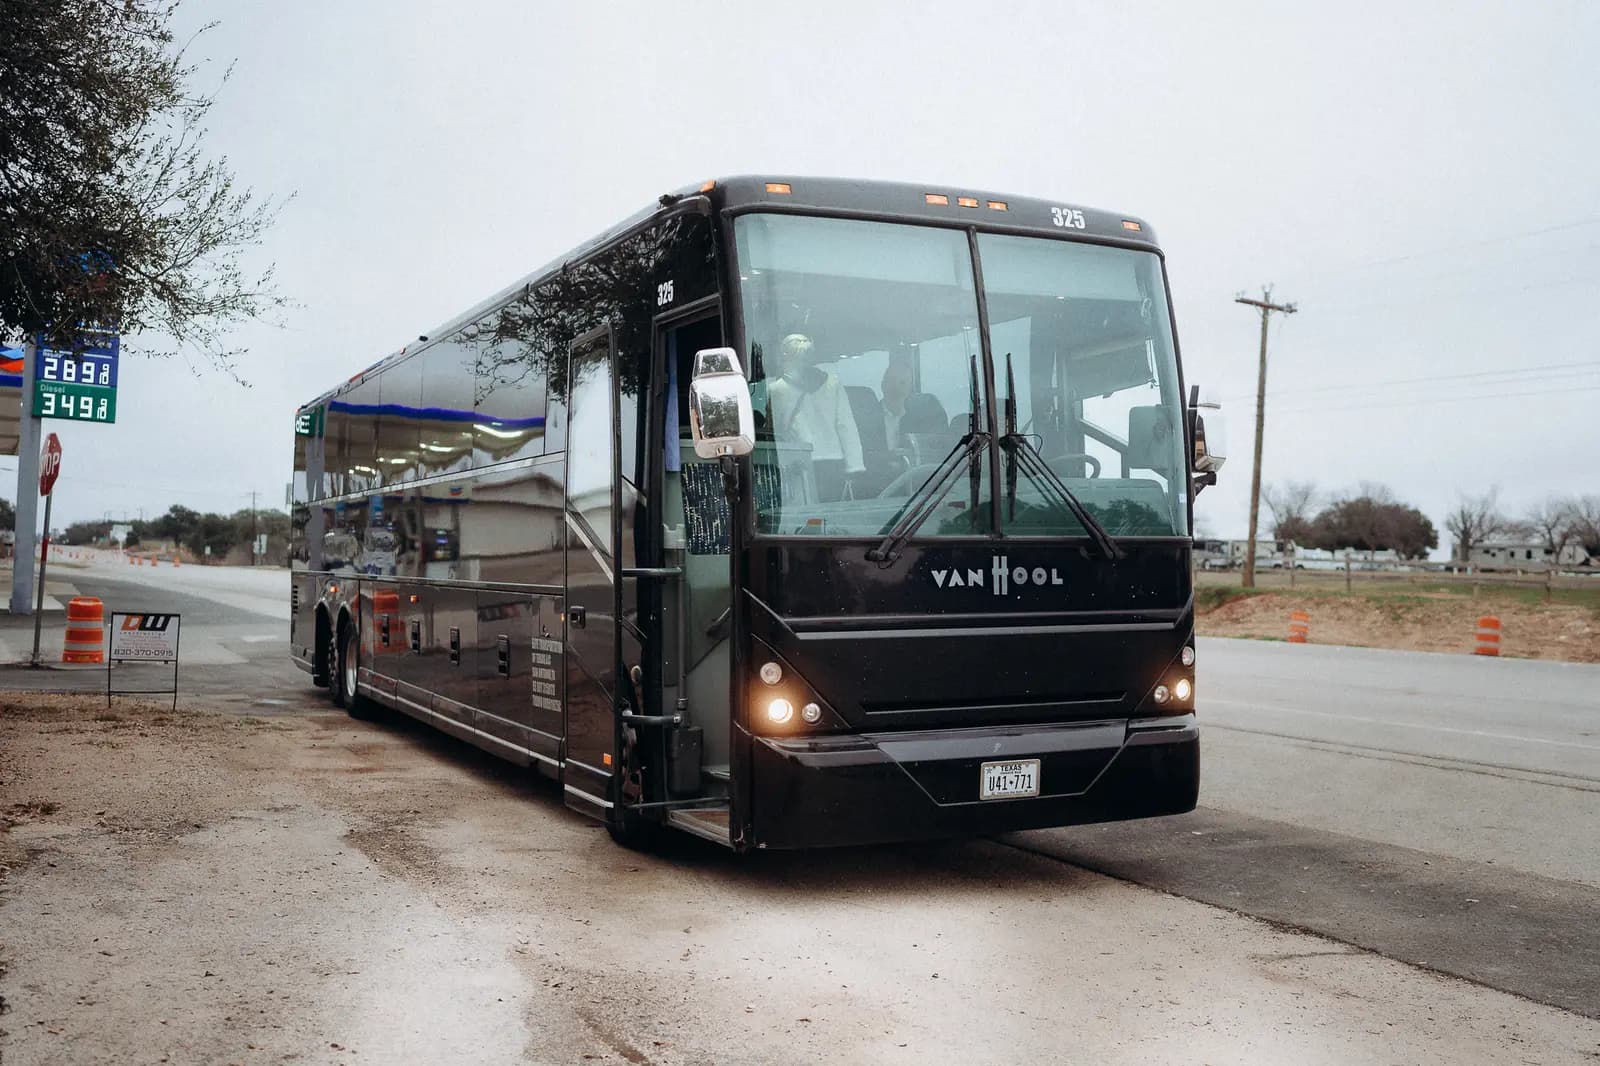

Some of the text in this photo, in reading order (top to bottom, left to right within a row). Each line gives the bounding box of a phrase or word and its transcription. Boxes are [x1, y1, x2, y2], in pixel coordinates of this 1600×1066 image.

[1051, 207, 1086, 229] 325
[657, 280, 673, 306] 325
[40, 384, 65, 394] Diesel
[931, 556, 1064, 595] VAN HOOL
[121, 615, 170, 631] DW
